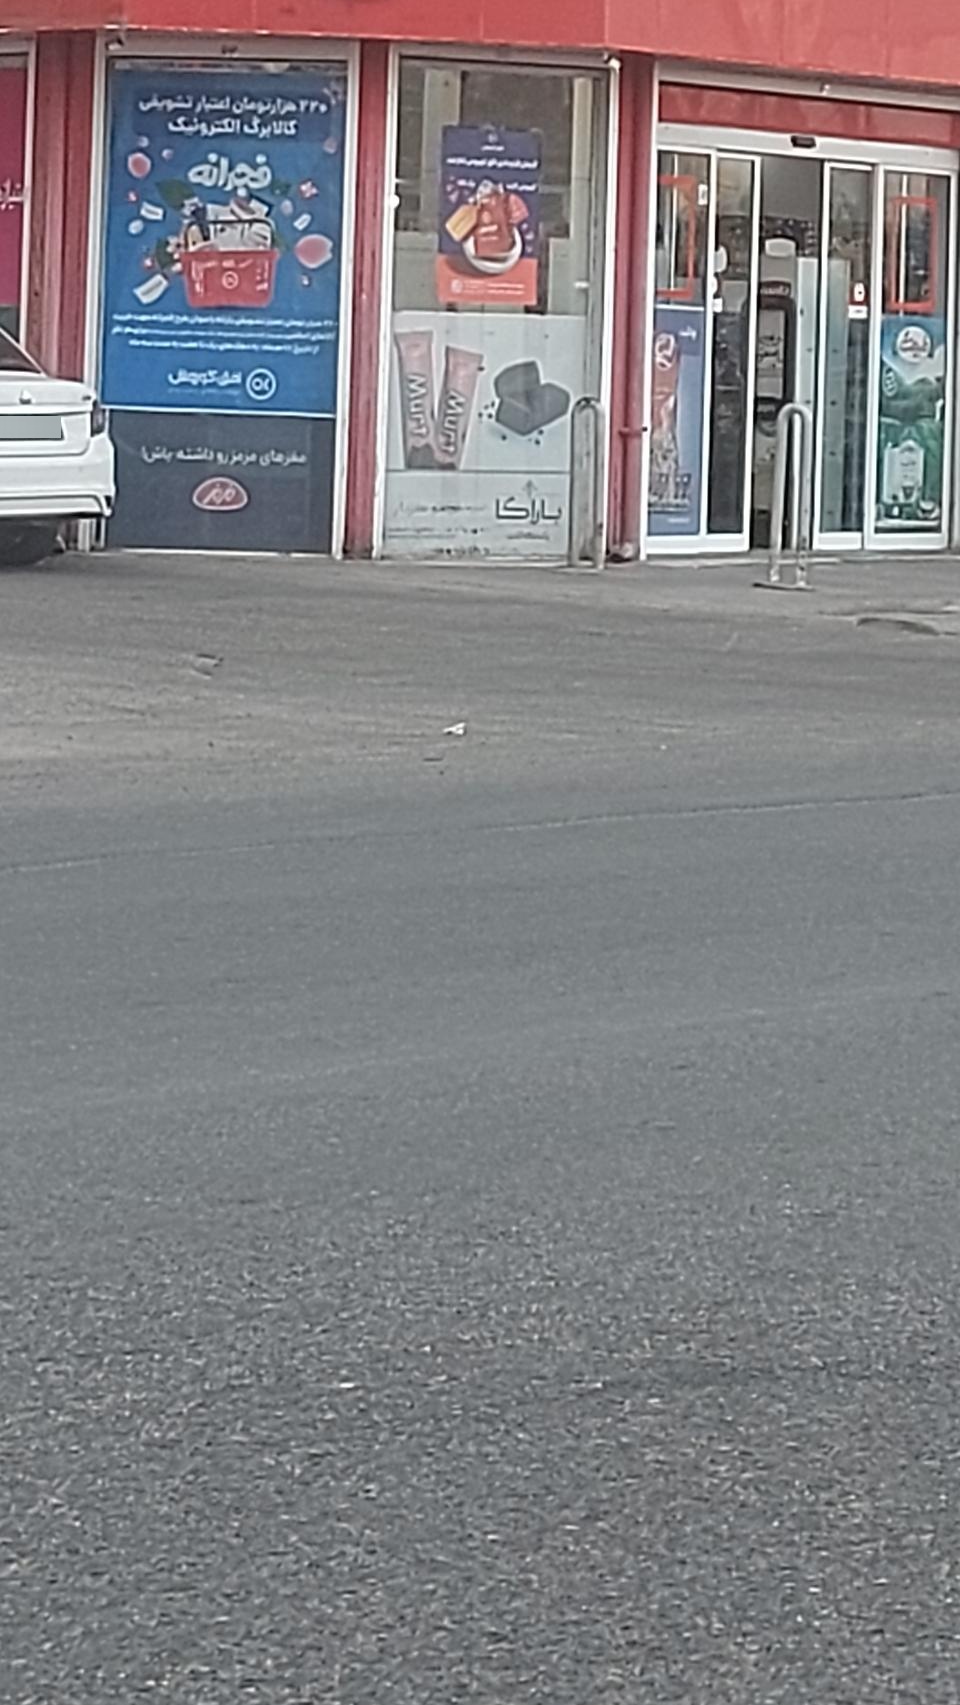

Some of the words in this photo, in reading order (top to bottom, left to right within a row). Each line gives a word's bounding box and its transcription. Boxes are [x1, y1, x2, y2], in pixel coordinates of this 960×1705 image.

[138, 94, 193, 112] تشویقی
[194, 95, 230, 113] اعتبار
[167, 116, 240, 137] الکترونیک
[176, 446, 214, 462] داشته
[495, 495, 562, 526] باراکا
